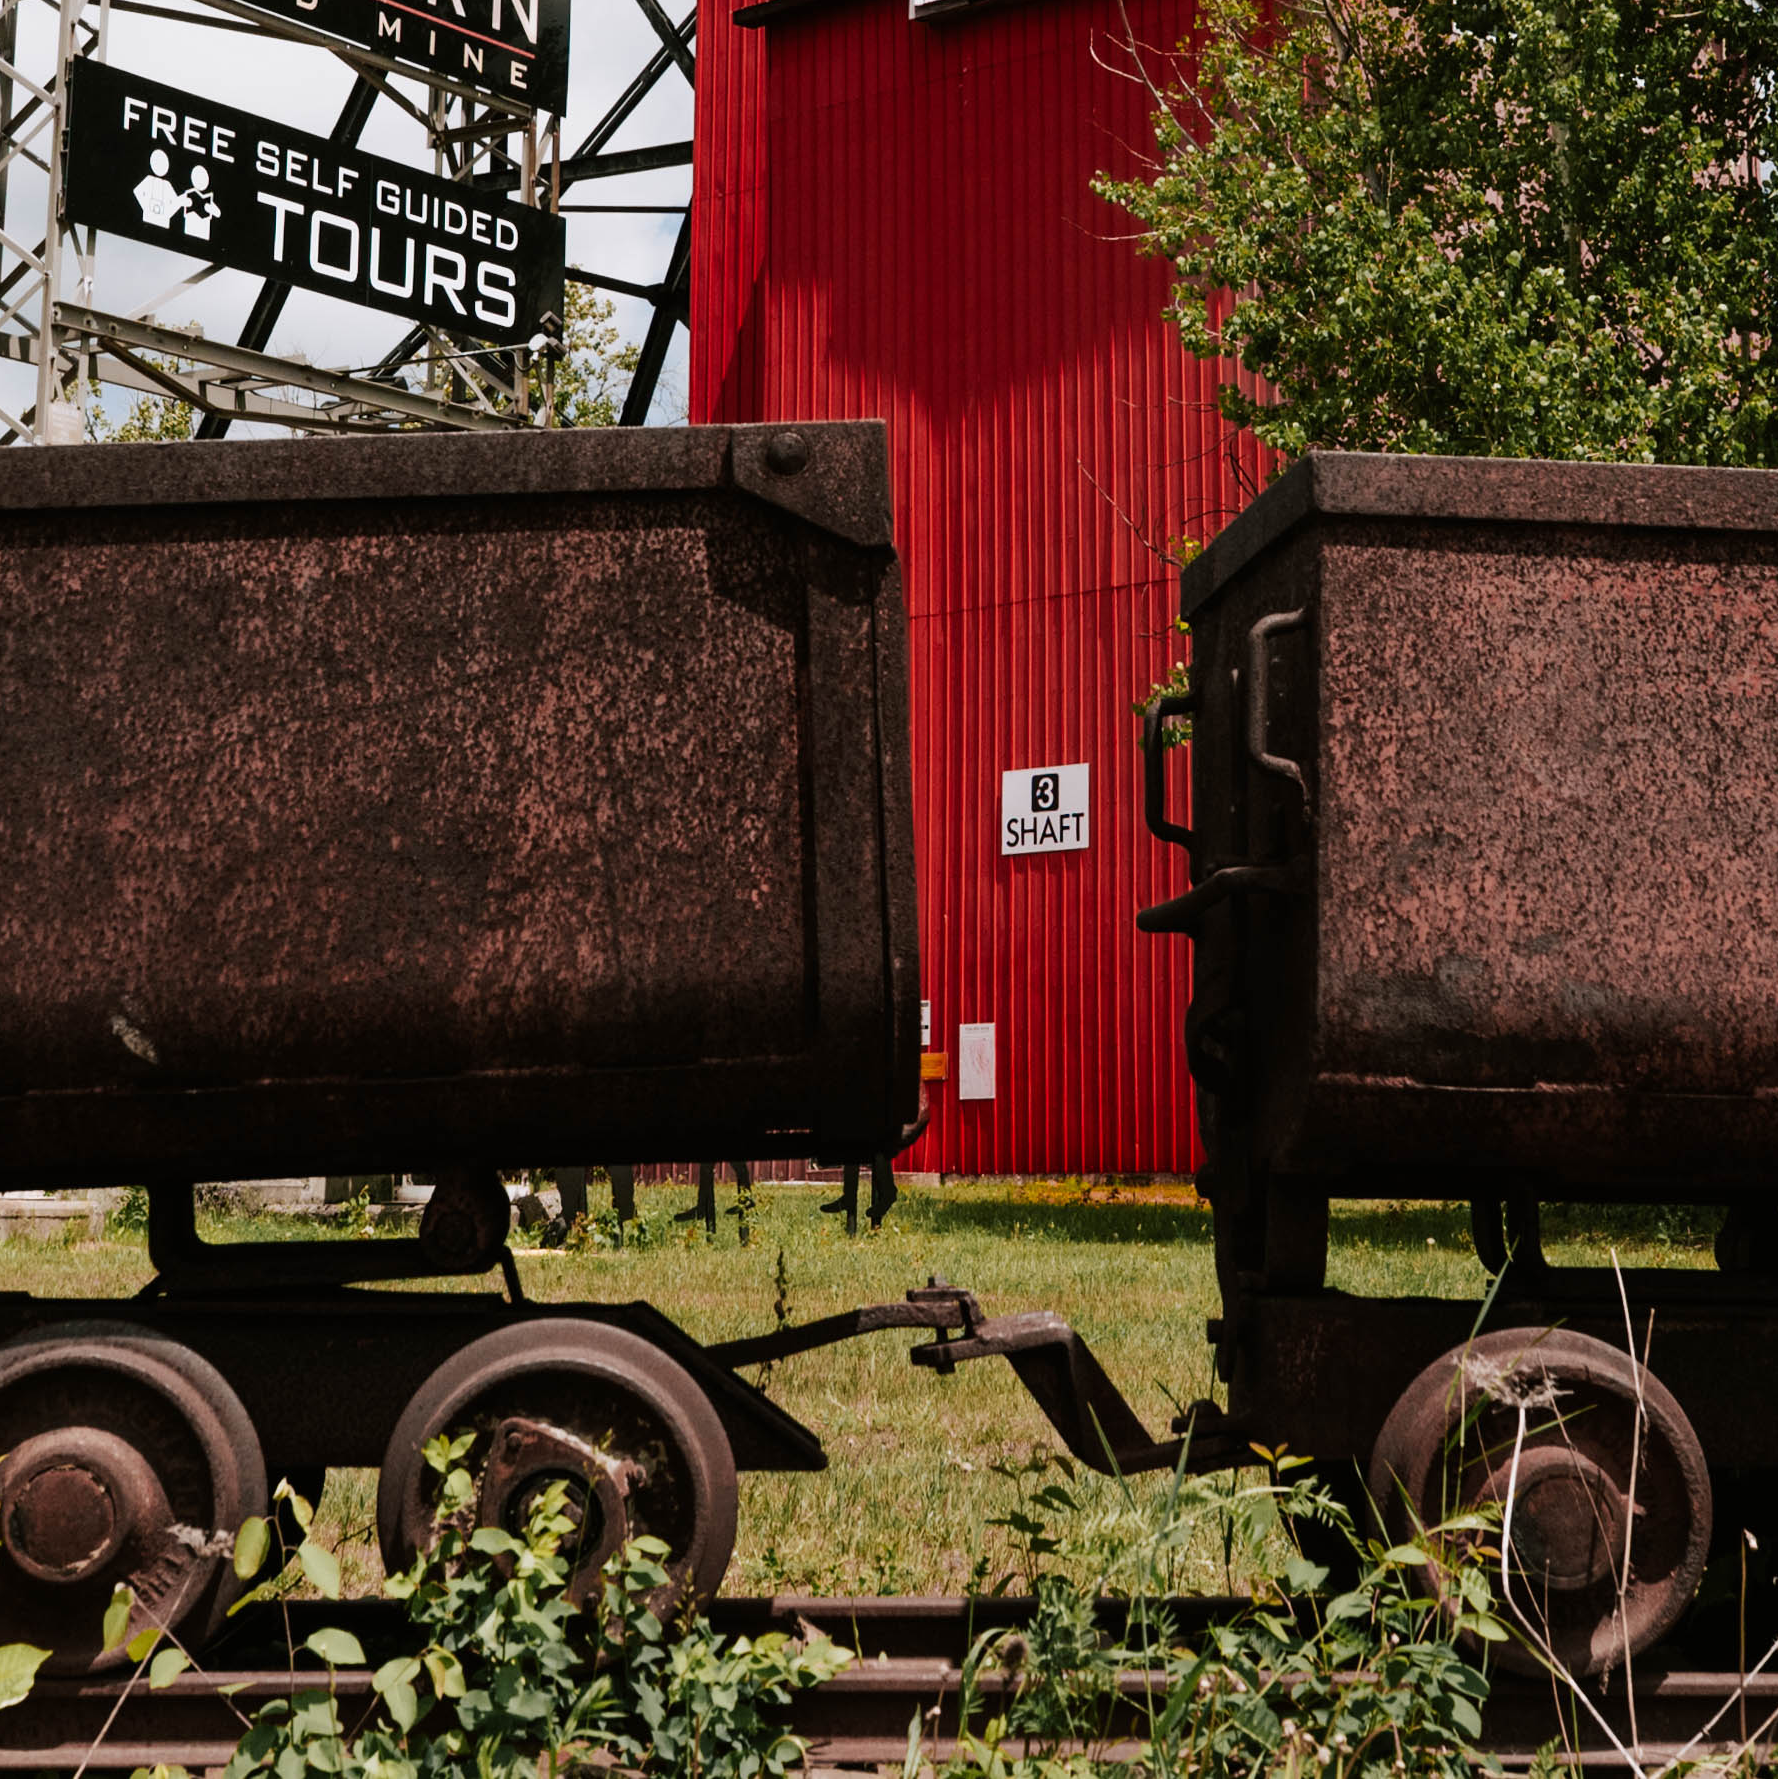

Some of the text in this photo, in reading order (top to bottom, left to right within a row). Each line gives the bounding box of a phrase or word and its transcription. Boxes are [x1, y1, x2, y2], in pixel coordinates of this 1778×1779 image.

[377, 10, 529, 90] MINE
[123, 95, 520, 253] FREE SELF GUIDED
[257, 191, 517, 328] TOURS
[1006, 812, 1085, 847] SHAFT
[1036, 776, 1054, 809] 3
